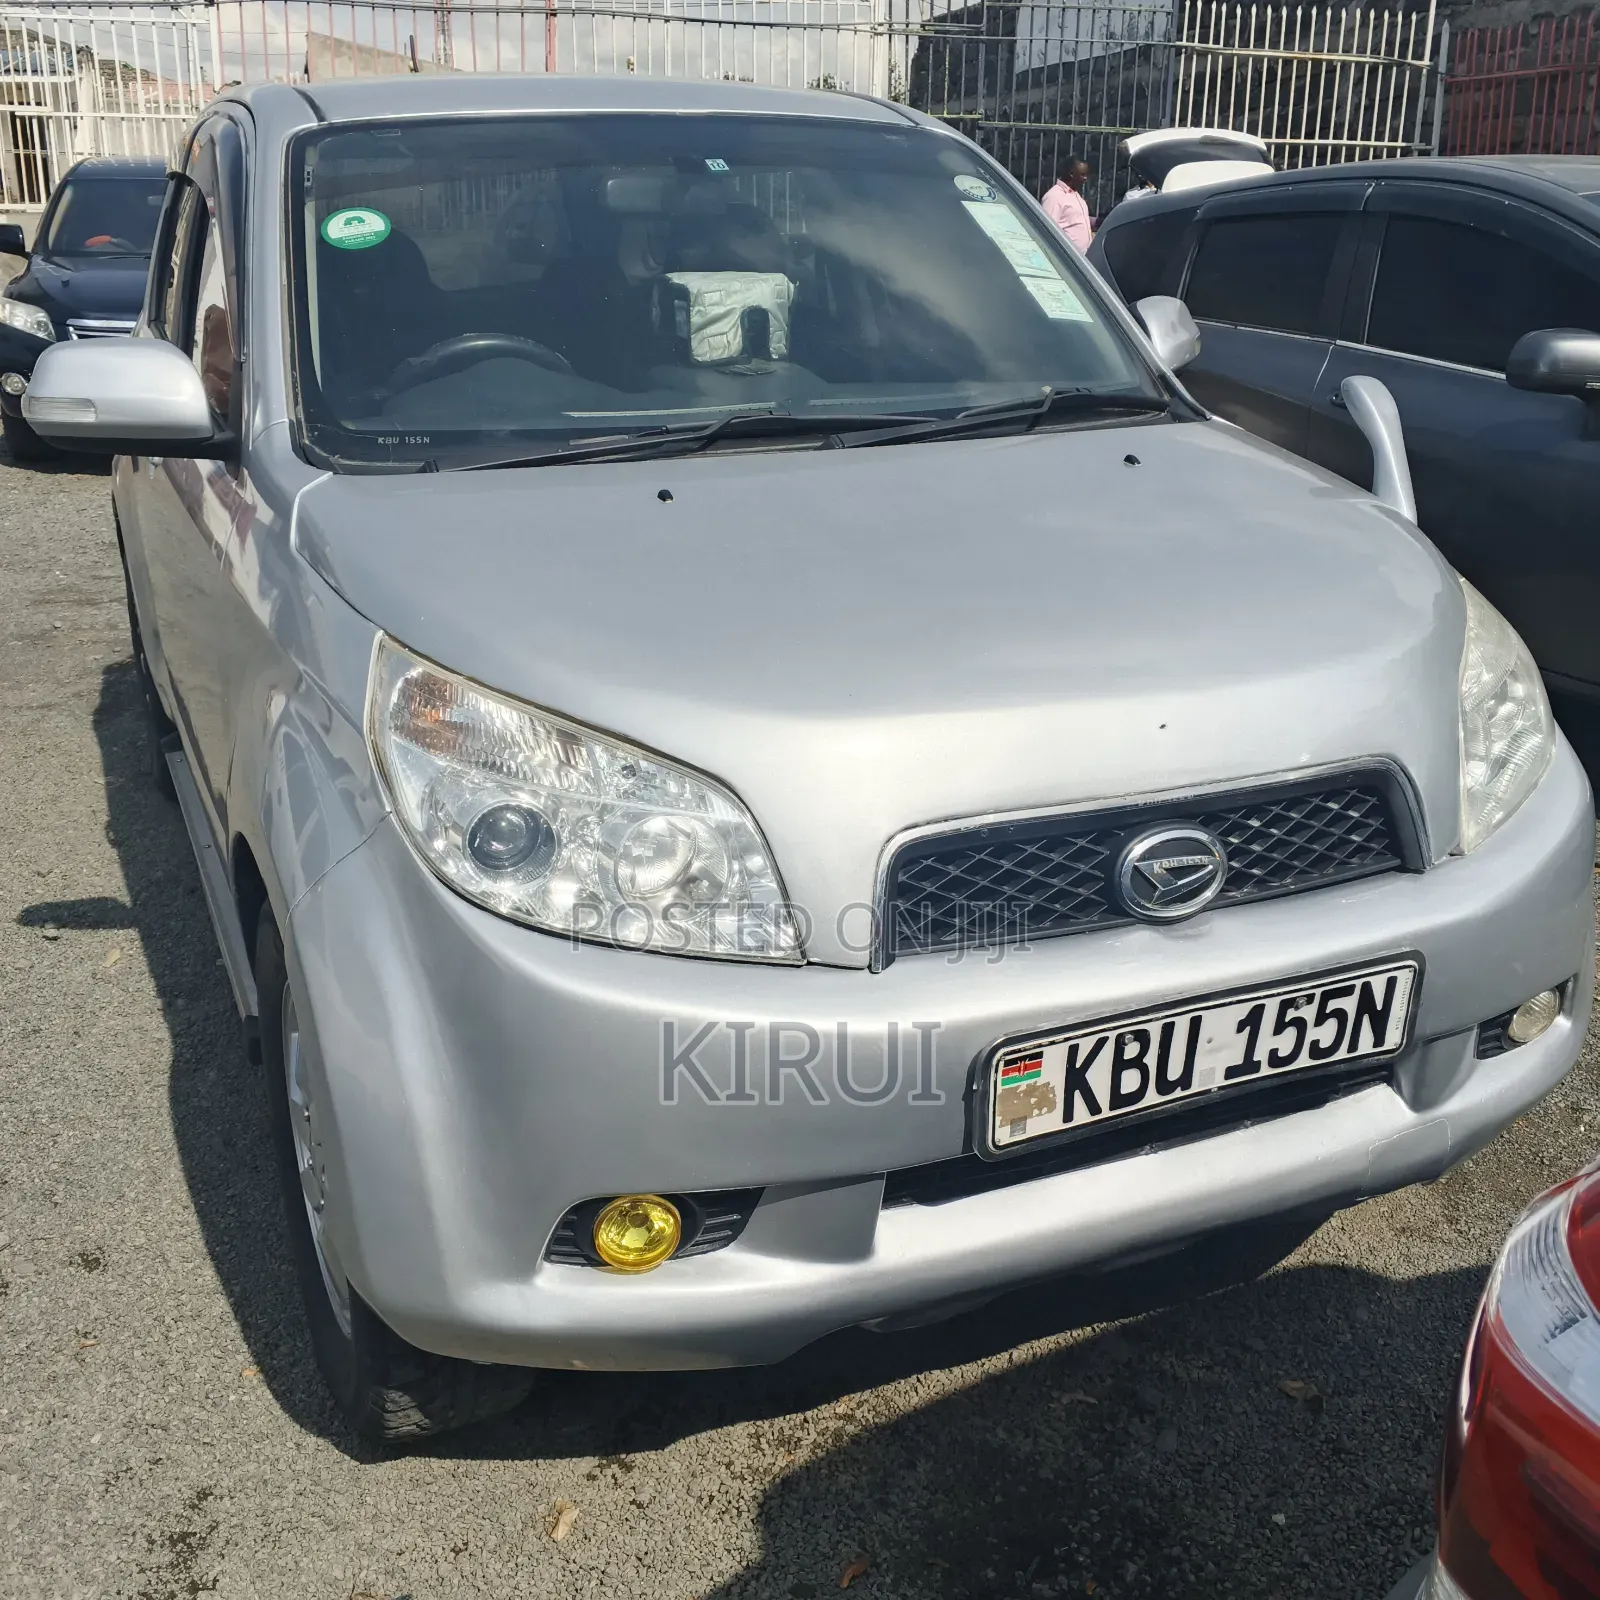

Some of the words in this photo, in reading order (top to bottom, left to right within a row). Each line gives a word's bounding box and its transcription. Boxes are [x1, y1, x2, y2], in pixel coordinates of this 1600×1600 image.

[377, 436, 400, 444] KBU
[404, 436, 430, 444] 155N
[1062, 1014, 1203, 1123] KBU
[1223, 975, 1399, 1081] 155N
